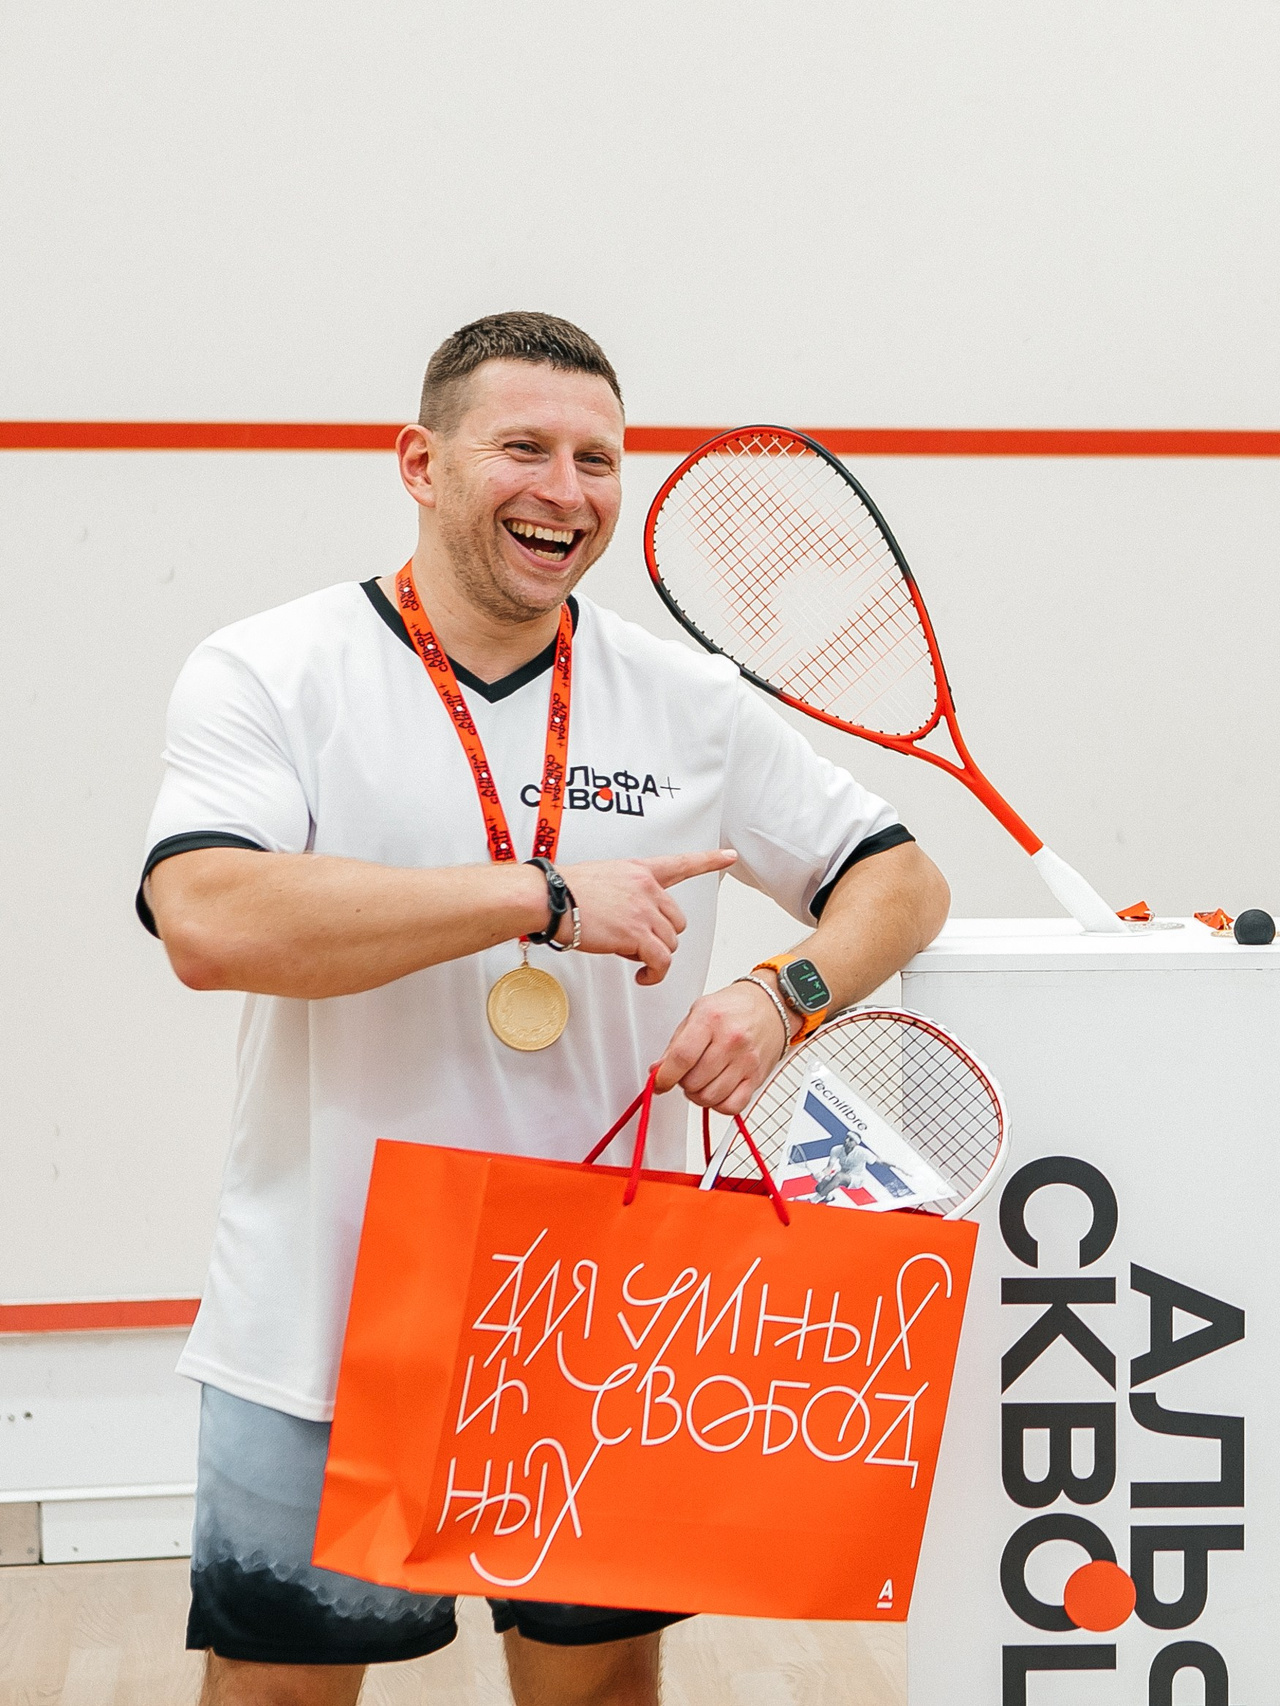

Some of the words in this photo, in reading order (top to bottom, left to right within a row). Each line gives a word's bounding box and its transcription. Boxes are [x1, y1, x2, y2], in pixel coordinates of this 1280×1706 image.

[520, 784, 644, 817] СВОШ
[541, 766, 681, 798] ЛЬФА+
[471, 1228, 599, 1369] ДЛЯ
[617, 1252, 953, 1442] УМНЫХ
[557, 1331, 930, 1490] СВОБОД
[435, 1438, 604, 1588] НЫХ
